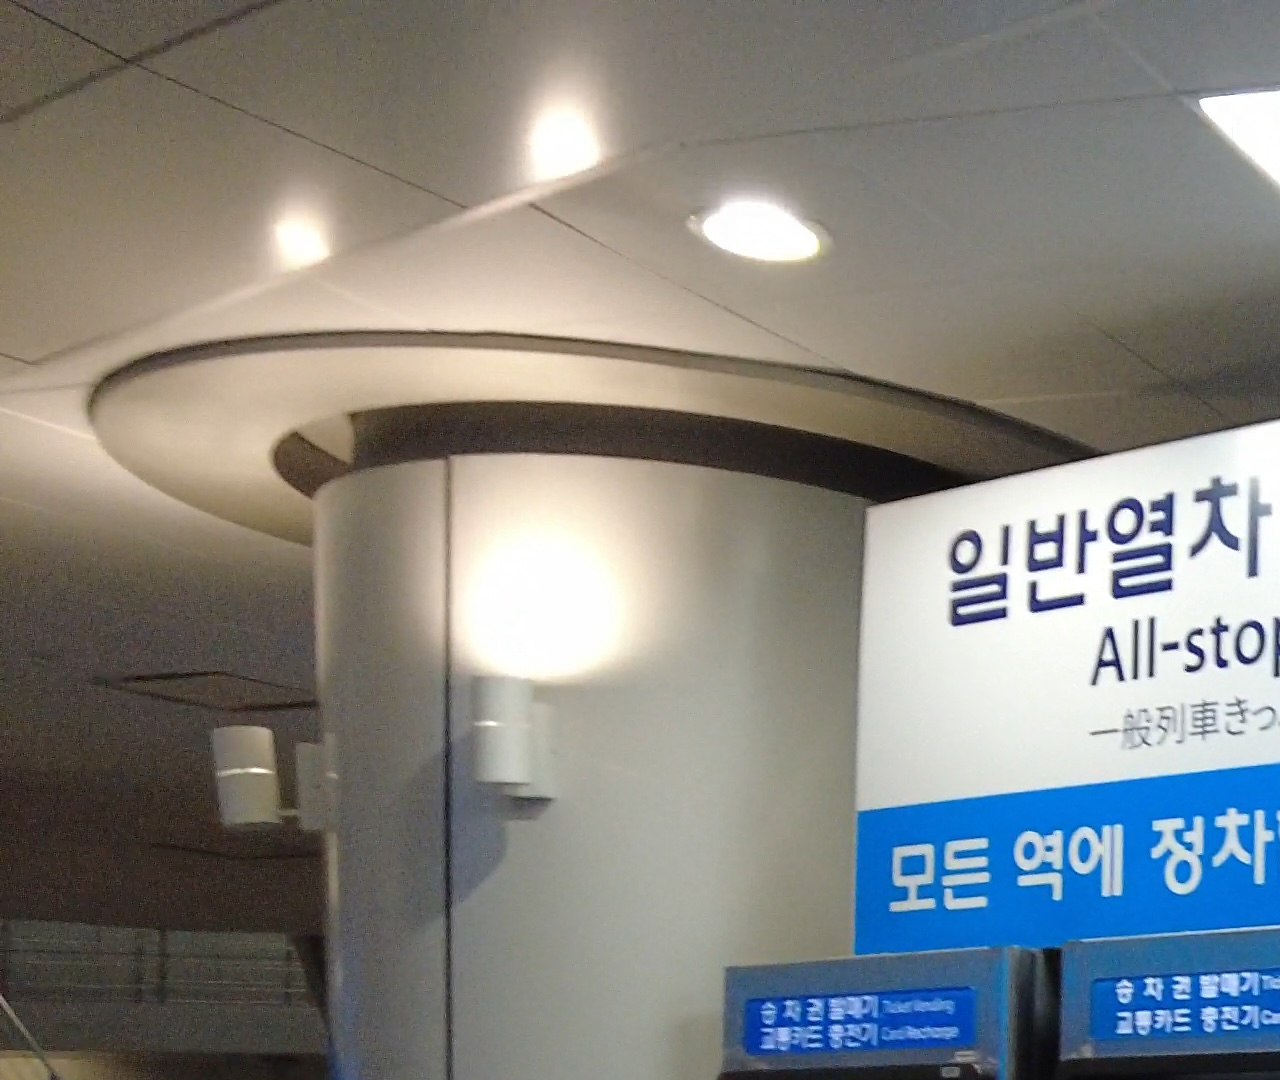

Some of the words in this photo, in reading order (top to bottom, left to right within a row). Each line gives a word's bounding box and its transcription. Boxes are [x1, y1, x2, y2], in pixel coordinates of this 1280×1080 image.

[948, 475, 1272, 627] 일반열차
[889, 836, 990, 913] 모든
[1013, 823, 1123, 900] 역에
